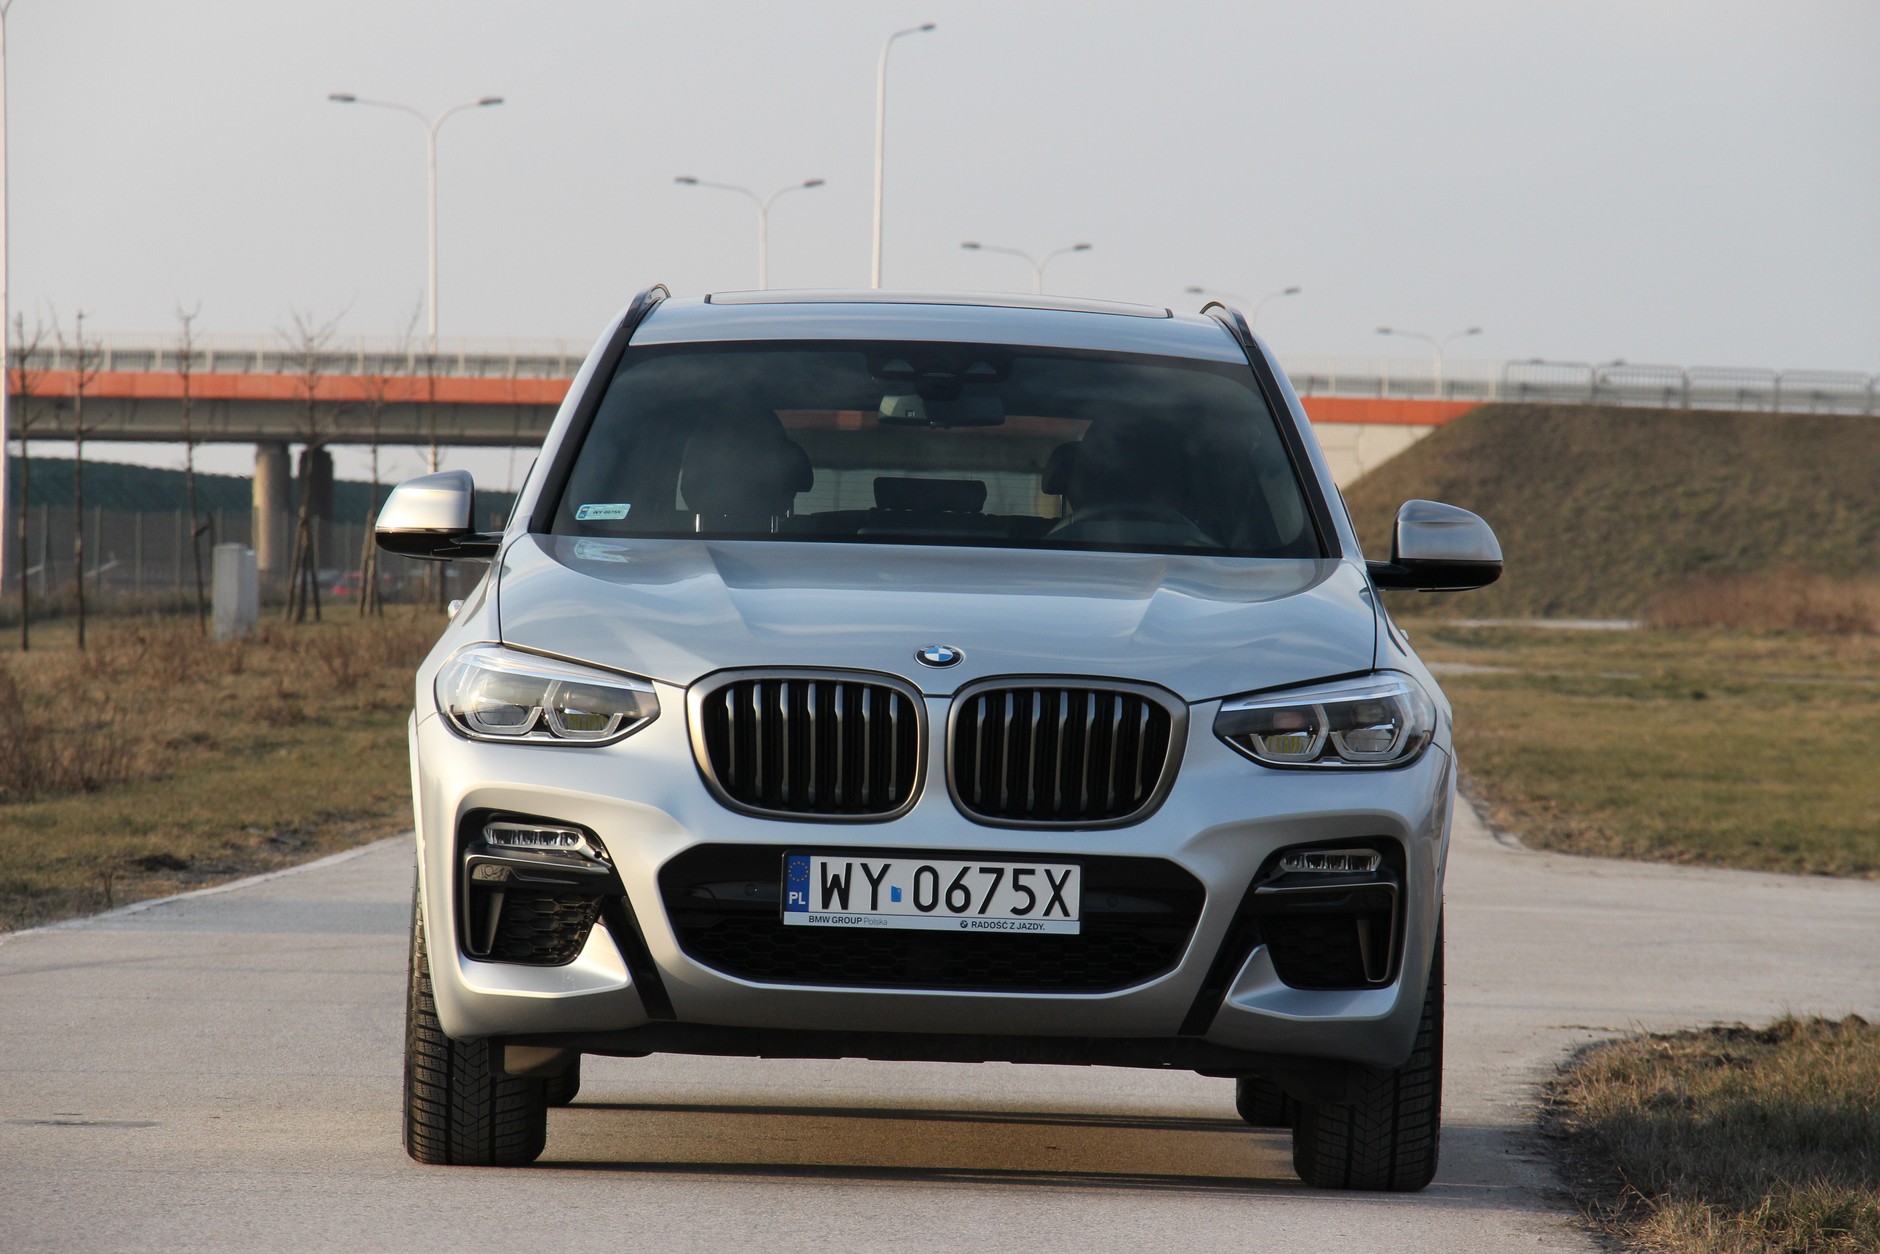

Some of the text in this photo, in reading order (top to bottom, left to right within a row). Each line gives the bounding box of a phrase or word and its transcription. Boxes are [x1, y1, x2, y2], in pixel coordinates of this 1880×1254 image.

[820, 861, 1072, 917] WY 0675X
[788, 891, 806, 905] PL
[808, 915, 888, 926] BMW GROUP Polska
[971, 920, 1008, 930] RADOŚĆ
[1016, 923, 1045, 931] JAZDY.
